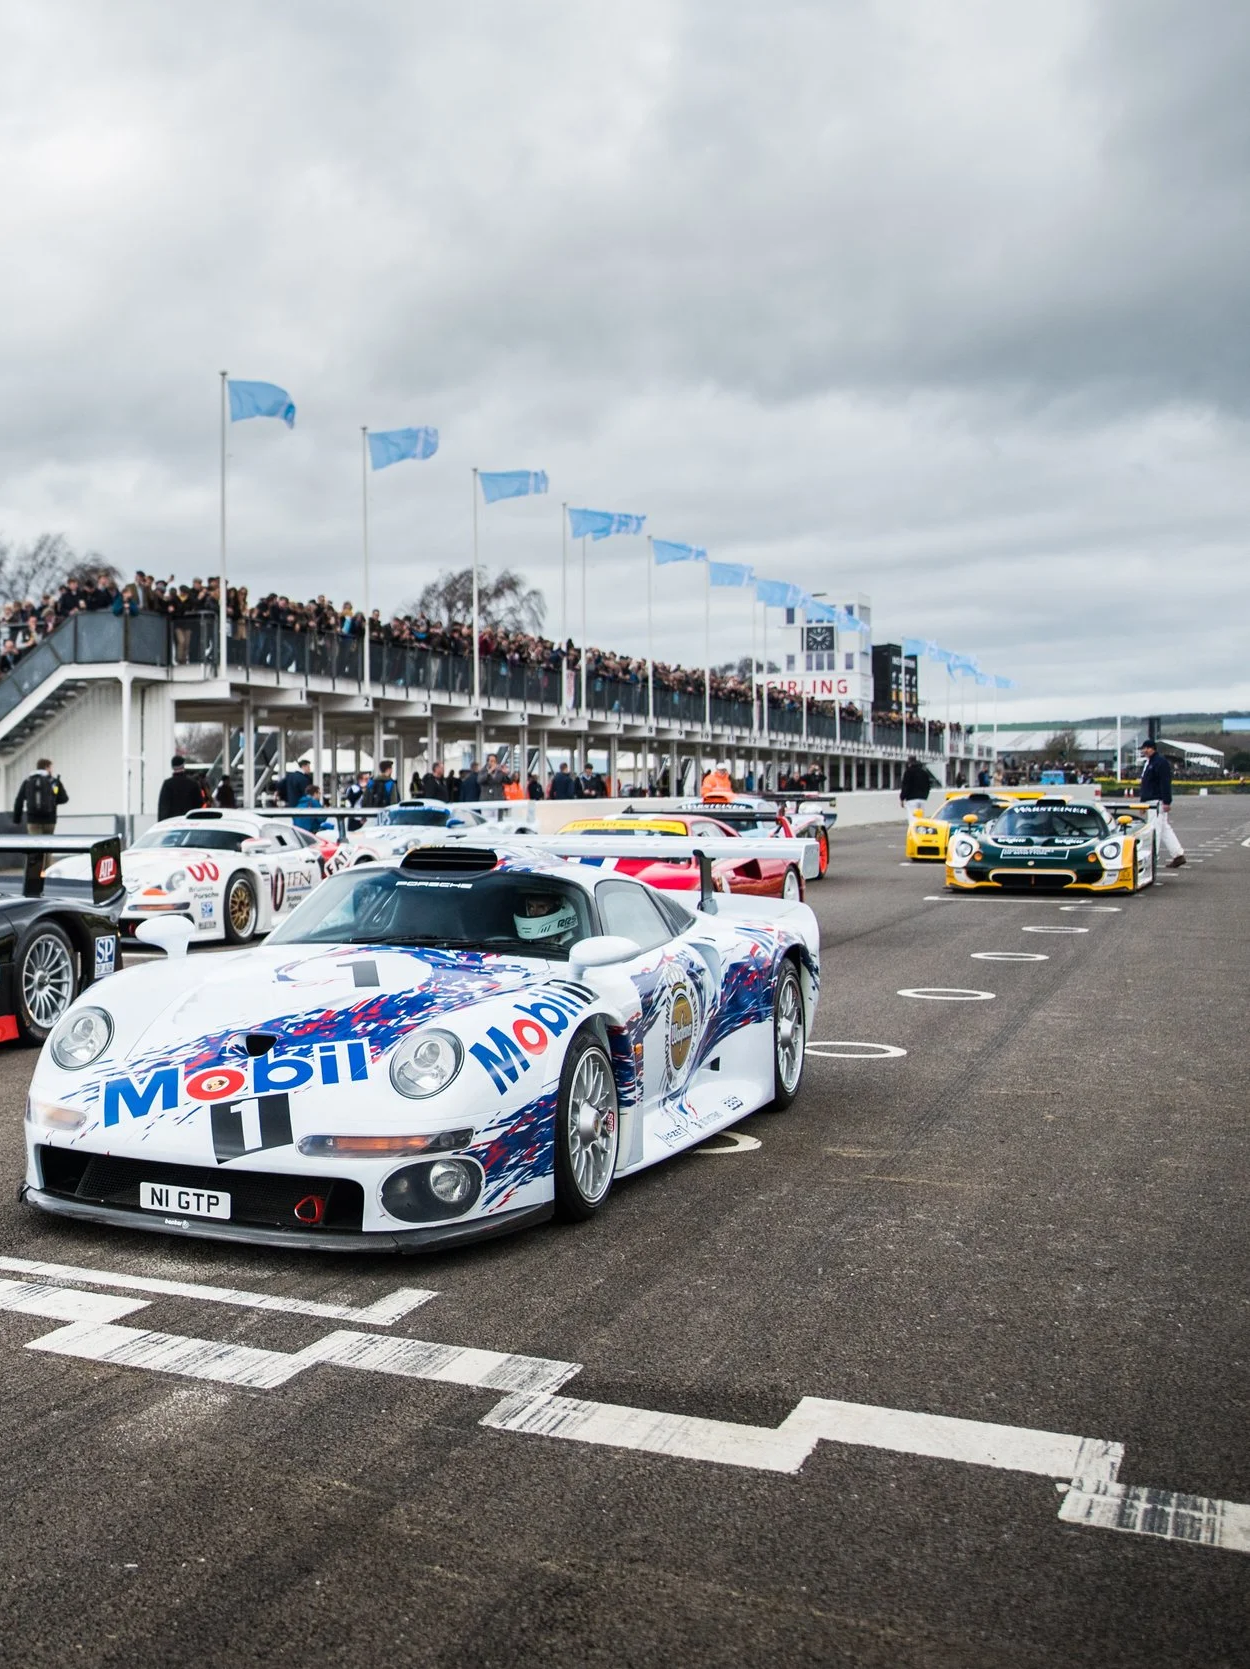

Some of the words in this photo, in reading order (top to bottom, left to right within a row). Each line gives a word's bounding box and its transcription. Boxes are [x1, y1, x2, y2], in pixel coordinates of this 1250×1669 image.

[98, 858, 114, 879] ATP
[396, 881, 473, 889] PORSCHE
[557, 914, 578, 929] RRS
[96, 939, 114, 963] SP
[336, 960, 380, 988] 1
[468, 988, 584, 1096] Mobil
[104, 1037, 369, 1128] Mobil
[150, 1187, 169, 1208] N1
[178, 1191, 221, 1214] GTP
